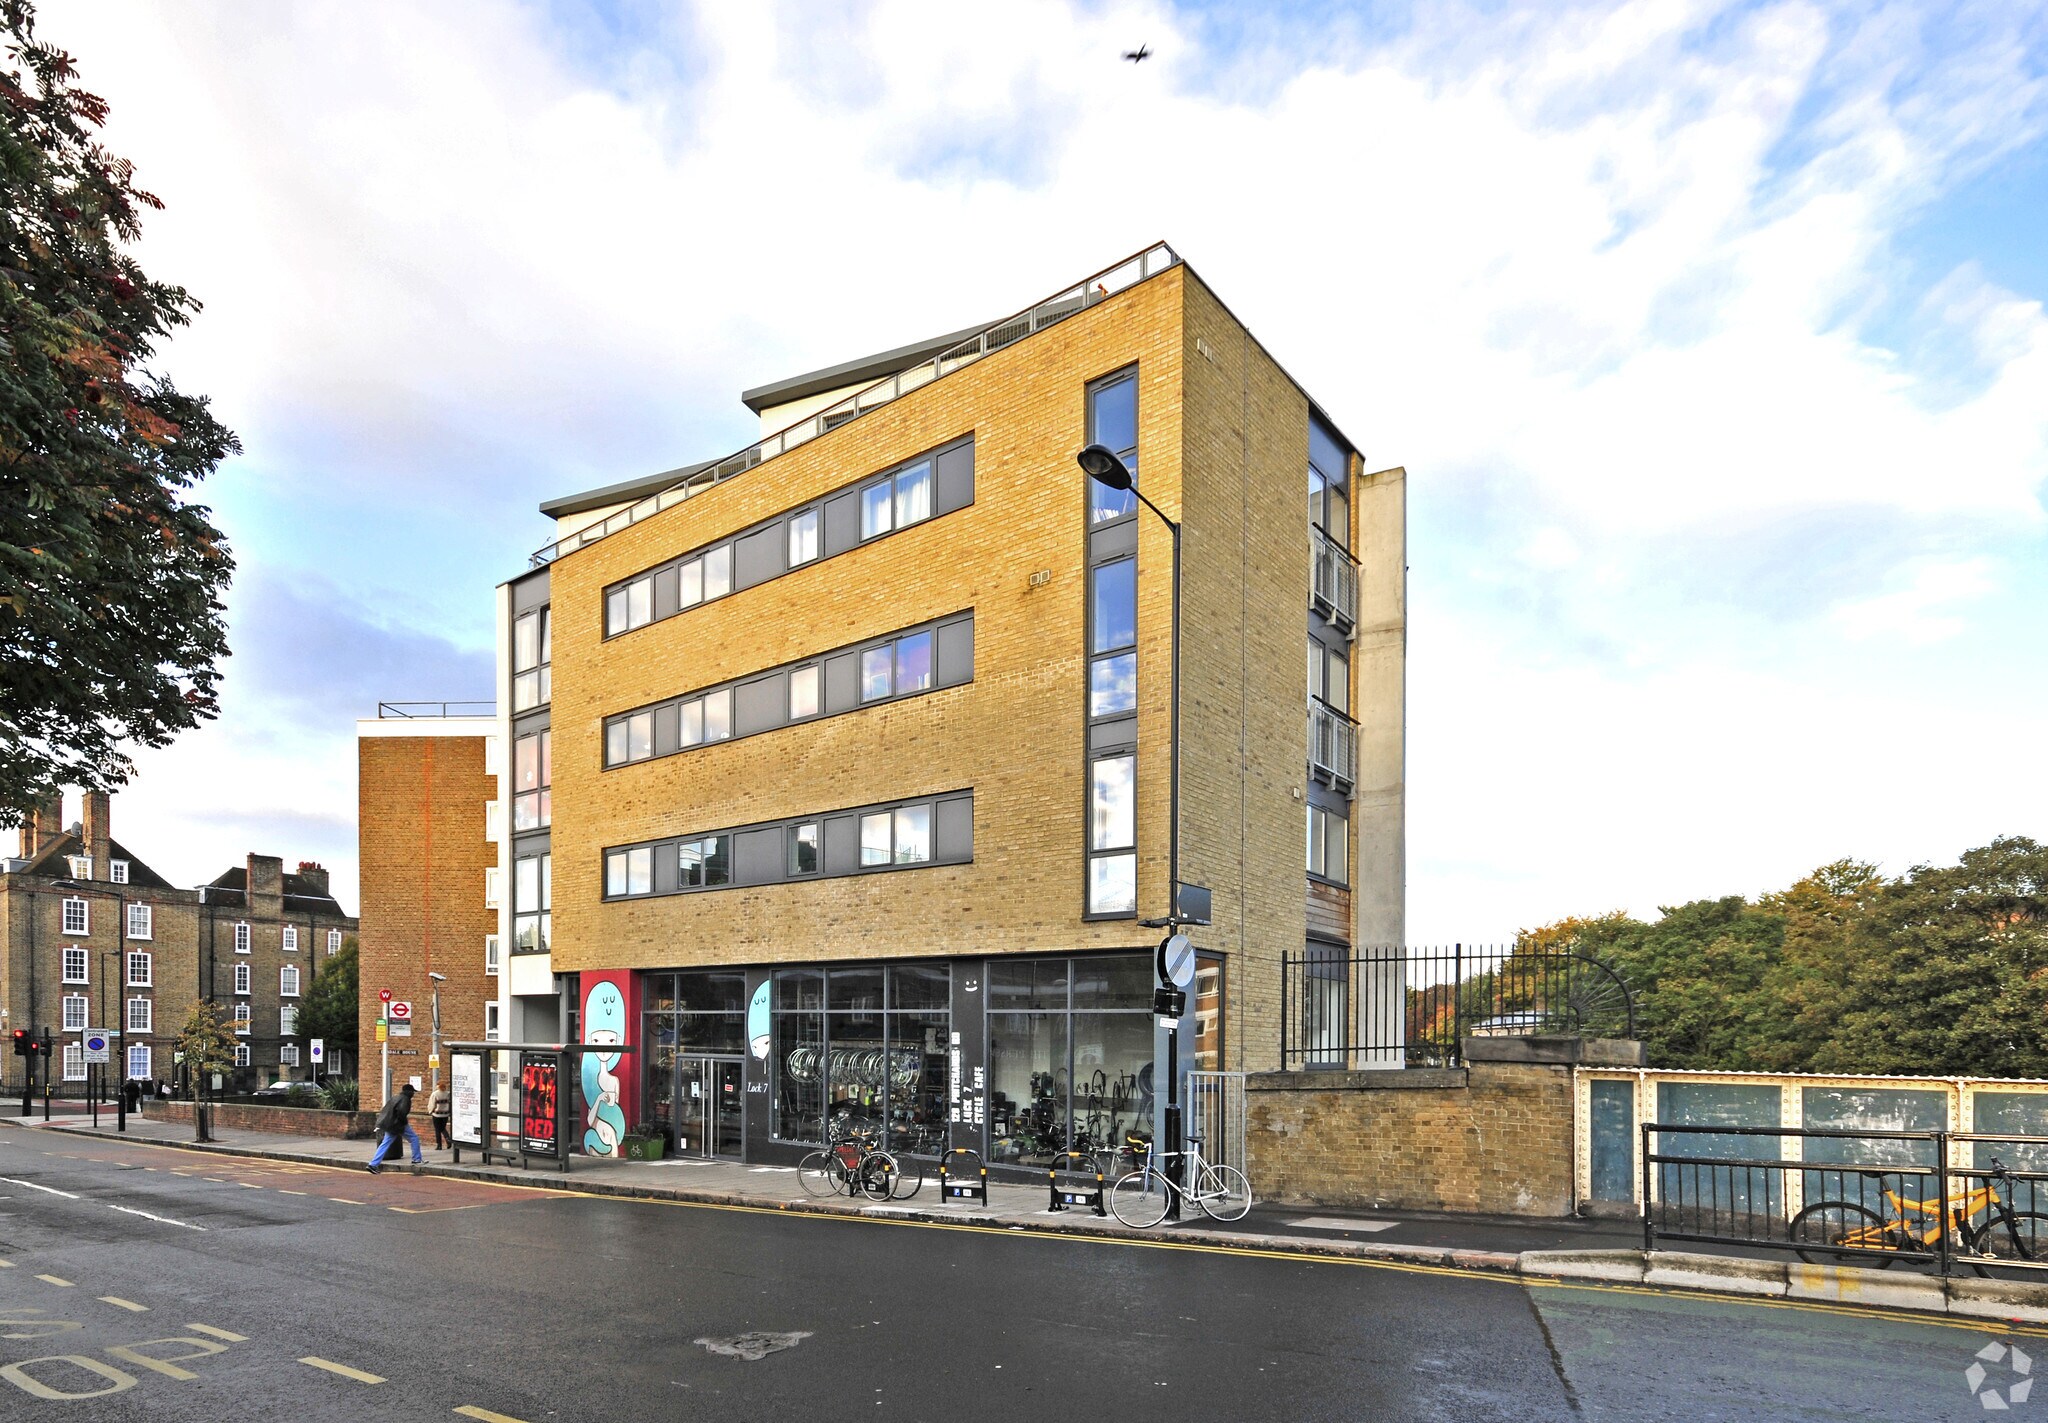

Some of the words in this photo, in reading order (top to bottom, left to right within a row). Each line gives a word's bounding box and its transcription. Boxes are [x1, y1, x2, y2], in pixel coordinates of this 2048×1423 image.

[764, 1083, 769, 1092] 7
[974, 1066, 983, 1089] CAFE
[974, 1096, 983, 1124] CYCLE
[524, 1117, 554, 1139] RED
